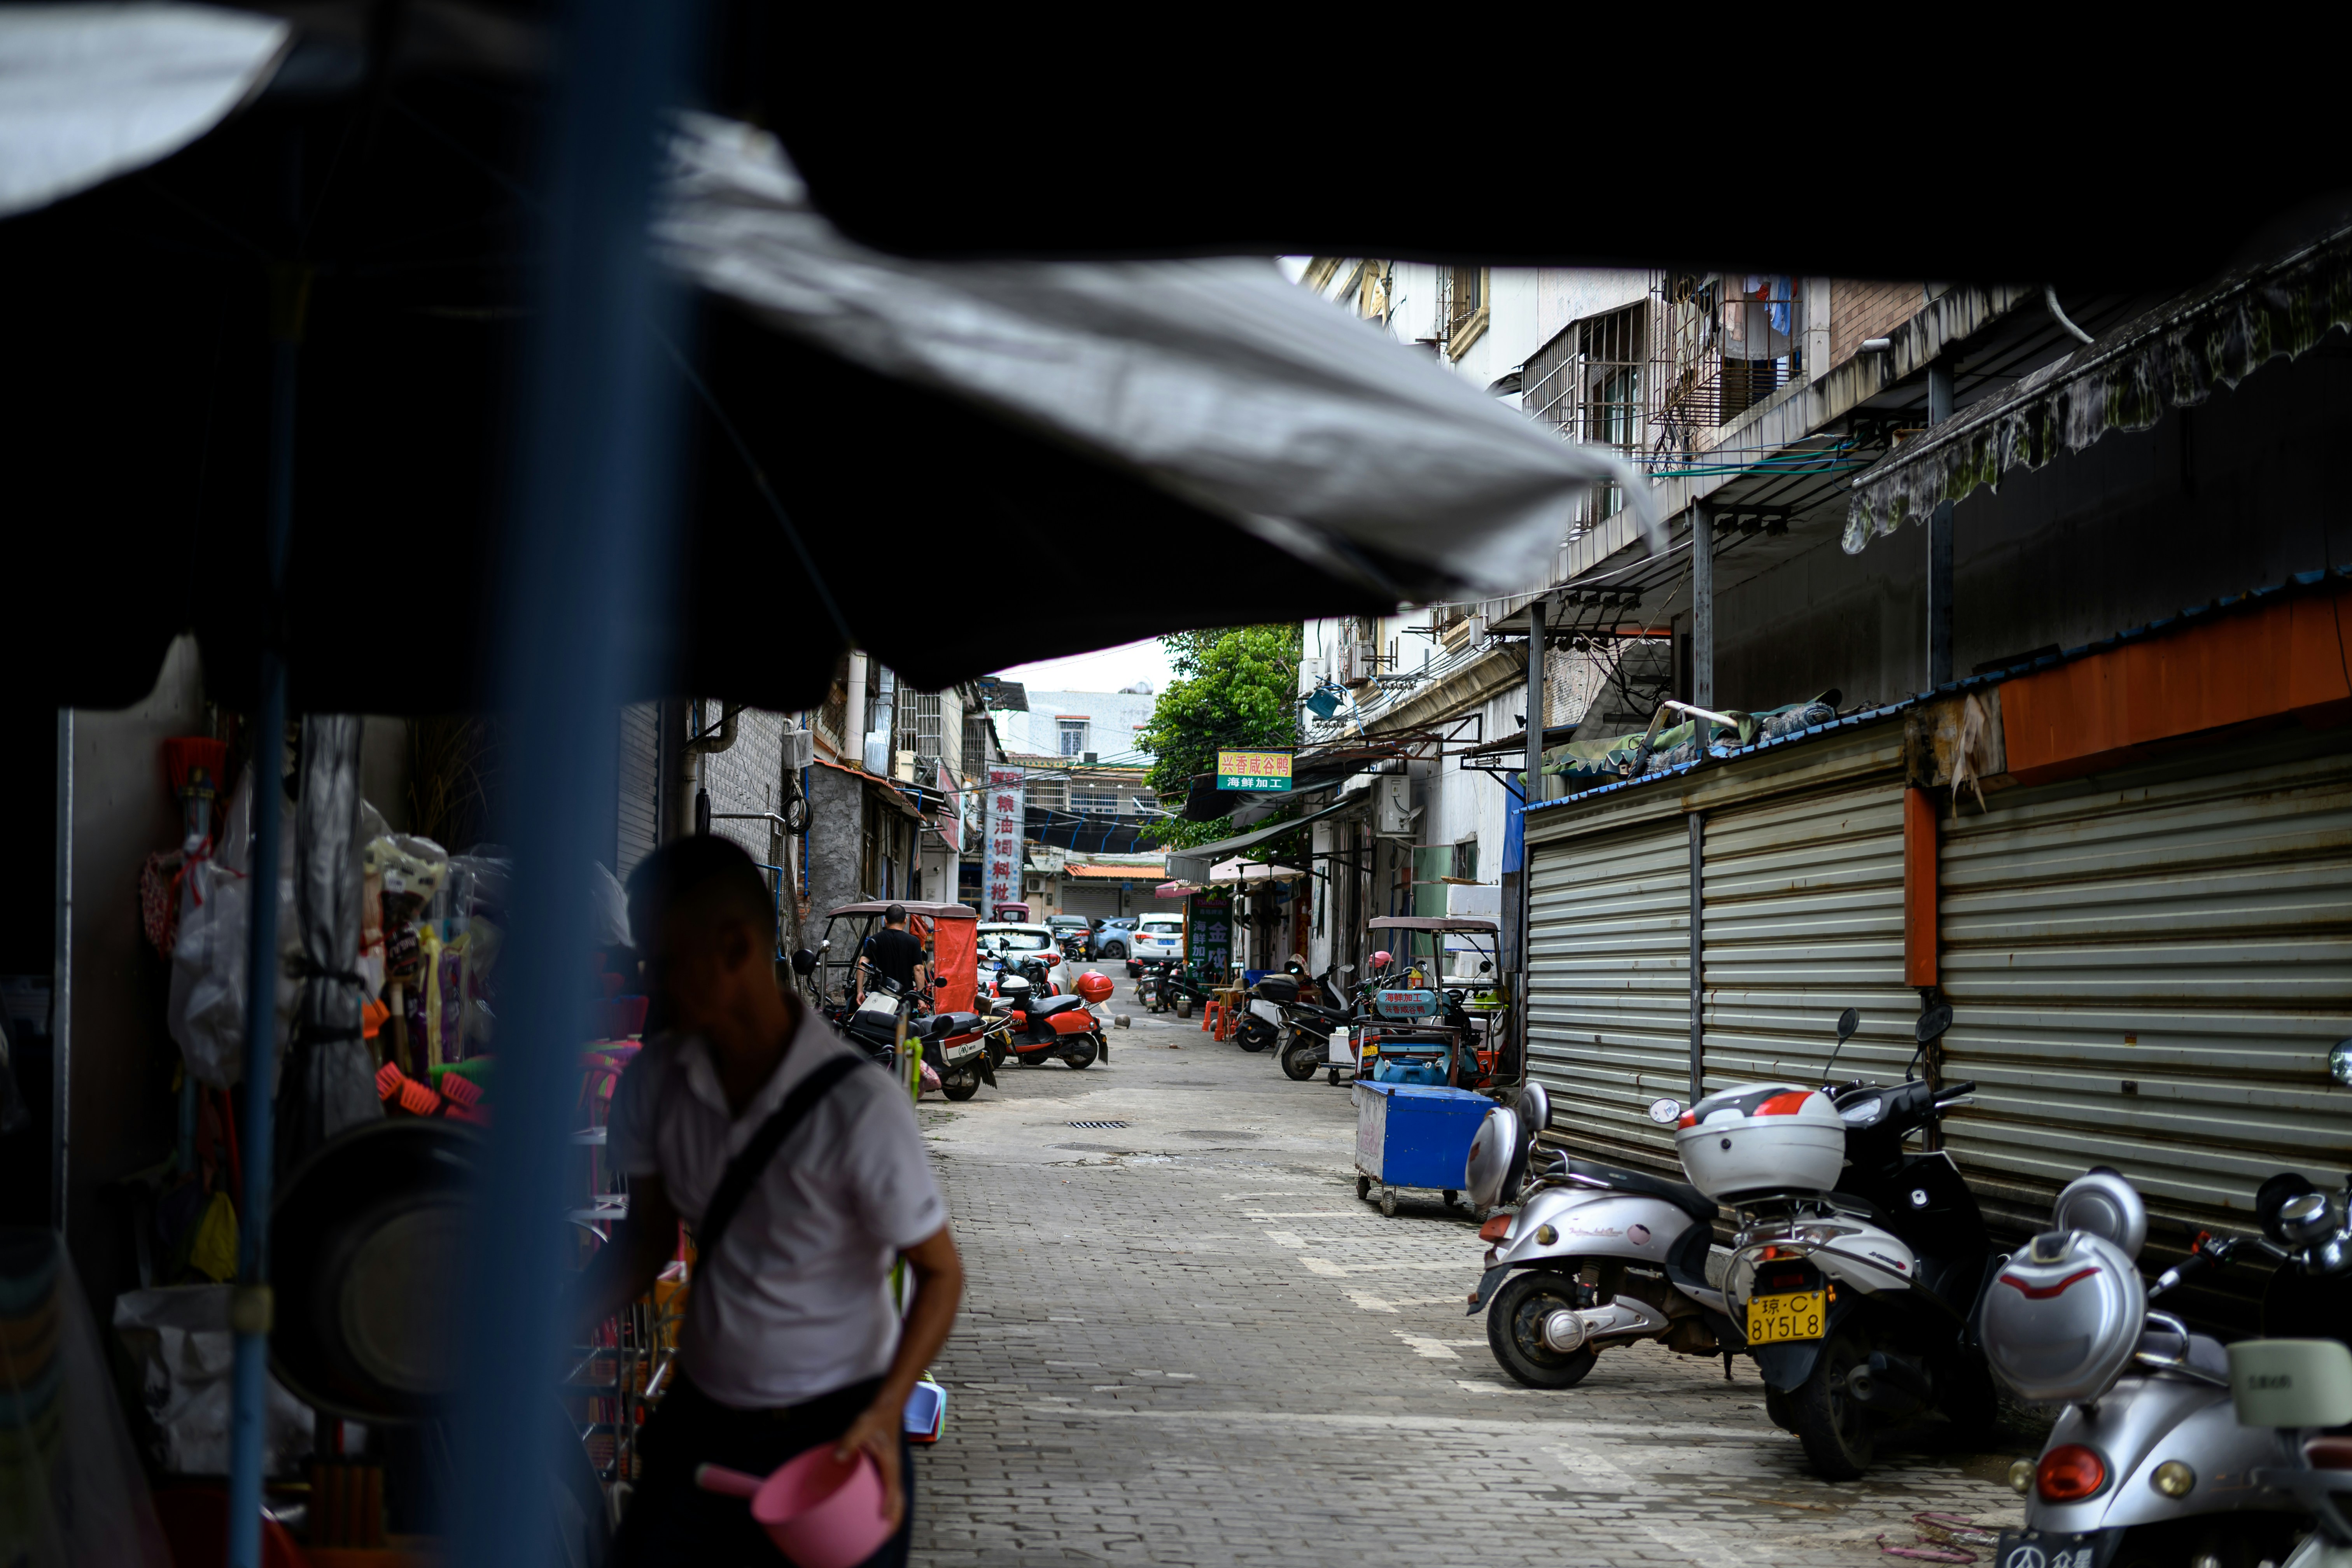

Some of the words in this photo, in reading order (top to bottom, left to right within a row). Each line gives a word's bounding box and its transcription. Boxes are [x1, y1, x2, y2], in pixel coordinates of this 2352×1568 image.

[1222, 755, 1288, 776] 兴香咸谷鸭
[1227, 777, 1282, 788] 海鲜加工
[989, 794, 1014, 922] 粮油饲料批
[1192, 920, 1206, 968] 海鲜加工
[1385, 993, 1422, 1003] 海鲜加工
[1385, 1005, 1425, 1014] 兴香咸谷鸭
[1752, 1314, 1819, 1340] 8Y5L8
